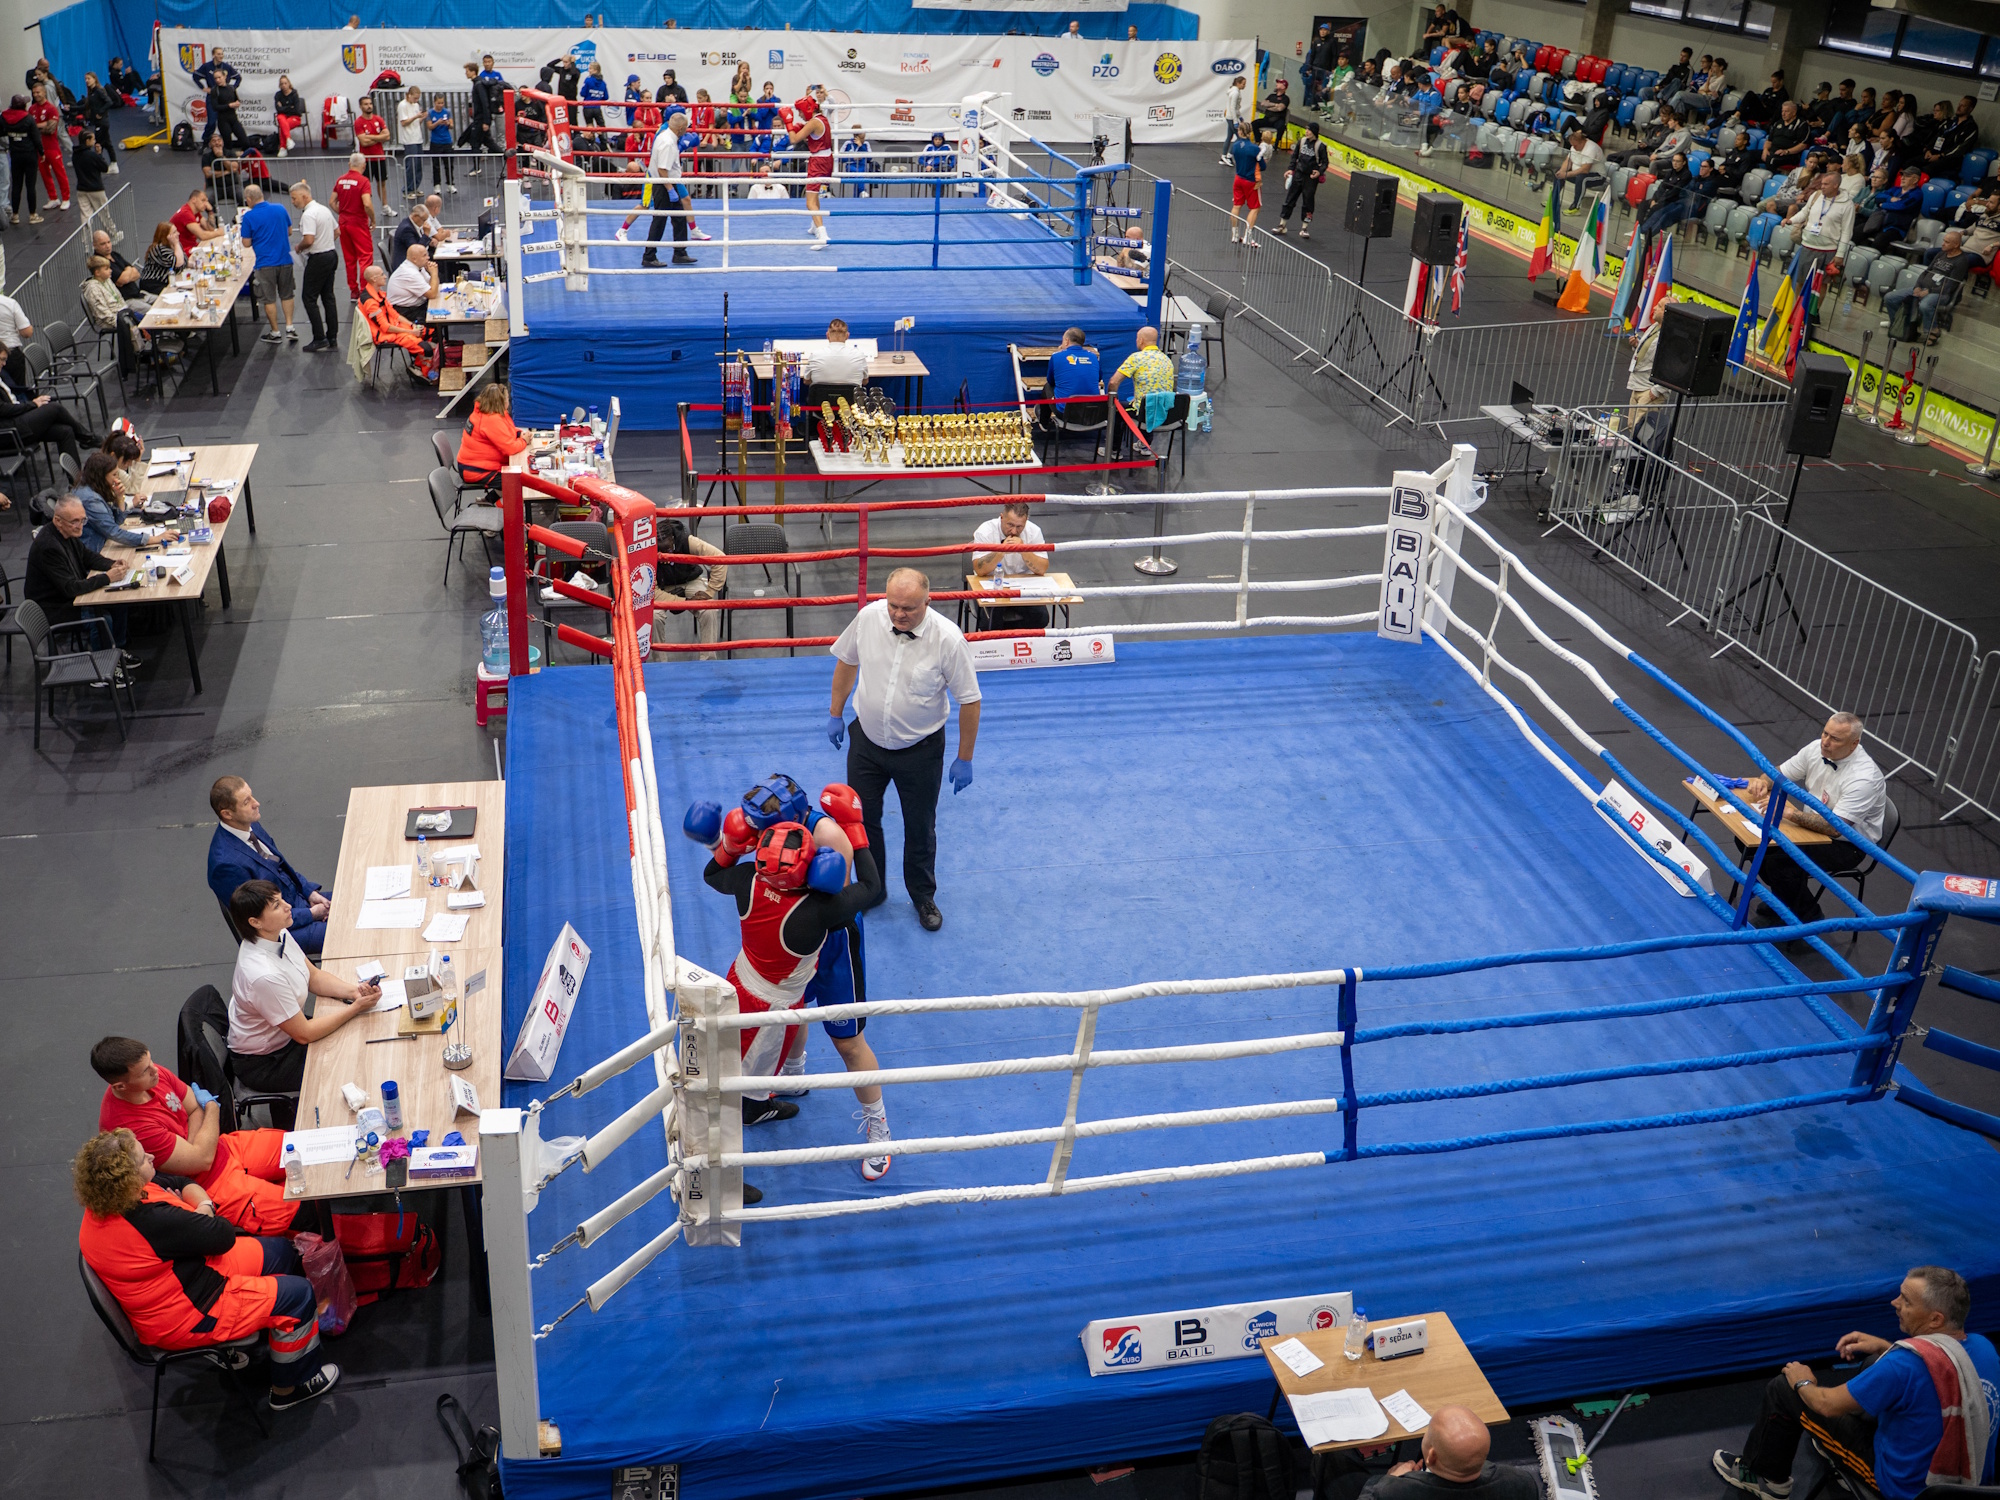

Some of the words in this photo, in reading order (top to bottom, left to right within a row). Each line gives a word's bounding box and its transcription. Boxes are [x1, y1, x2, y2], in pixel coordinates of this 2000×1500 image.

[1092, 66, 1119, 77] PZO
[554, 106, 566, 119] B
[1493, 215, 1515, 232] Jasna
[1516, 225, 1536, 244] TENIS
[1553, 240, 1571, 256] asna
[1393, 486, 1429, 520] B
[633, 516, 652, 542] B
[628, 538, 656, 553] BAIL
[1390, 534, 1417, 629] BAIL
[1013, 641, 1032, 657] B
[1987, 880, 1998, 899] POLSKA
[544, 999, 560, 1025] B
[555, 1013, 567, 1038] BAIL
[686, 1034, 697, 1066] BAIL
[685, 1066, 700, 1076] B
[690, 1169, 701, 1190] AIL
[689, 1190, 703, 1200] B
[1174, 1318, 1207, 1346] B
[1259, 1328, 1275, 1337] UKS
[1389, 1332, 1413, 1343] SĘDZIA
[1396, 1327, 1403, 1335] 3
[1167, 1346, 1214, 1360] BAIL
[623, 1466, 653, 1482] B
